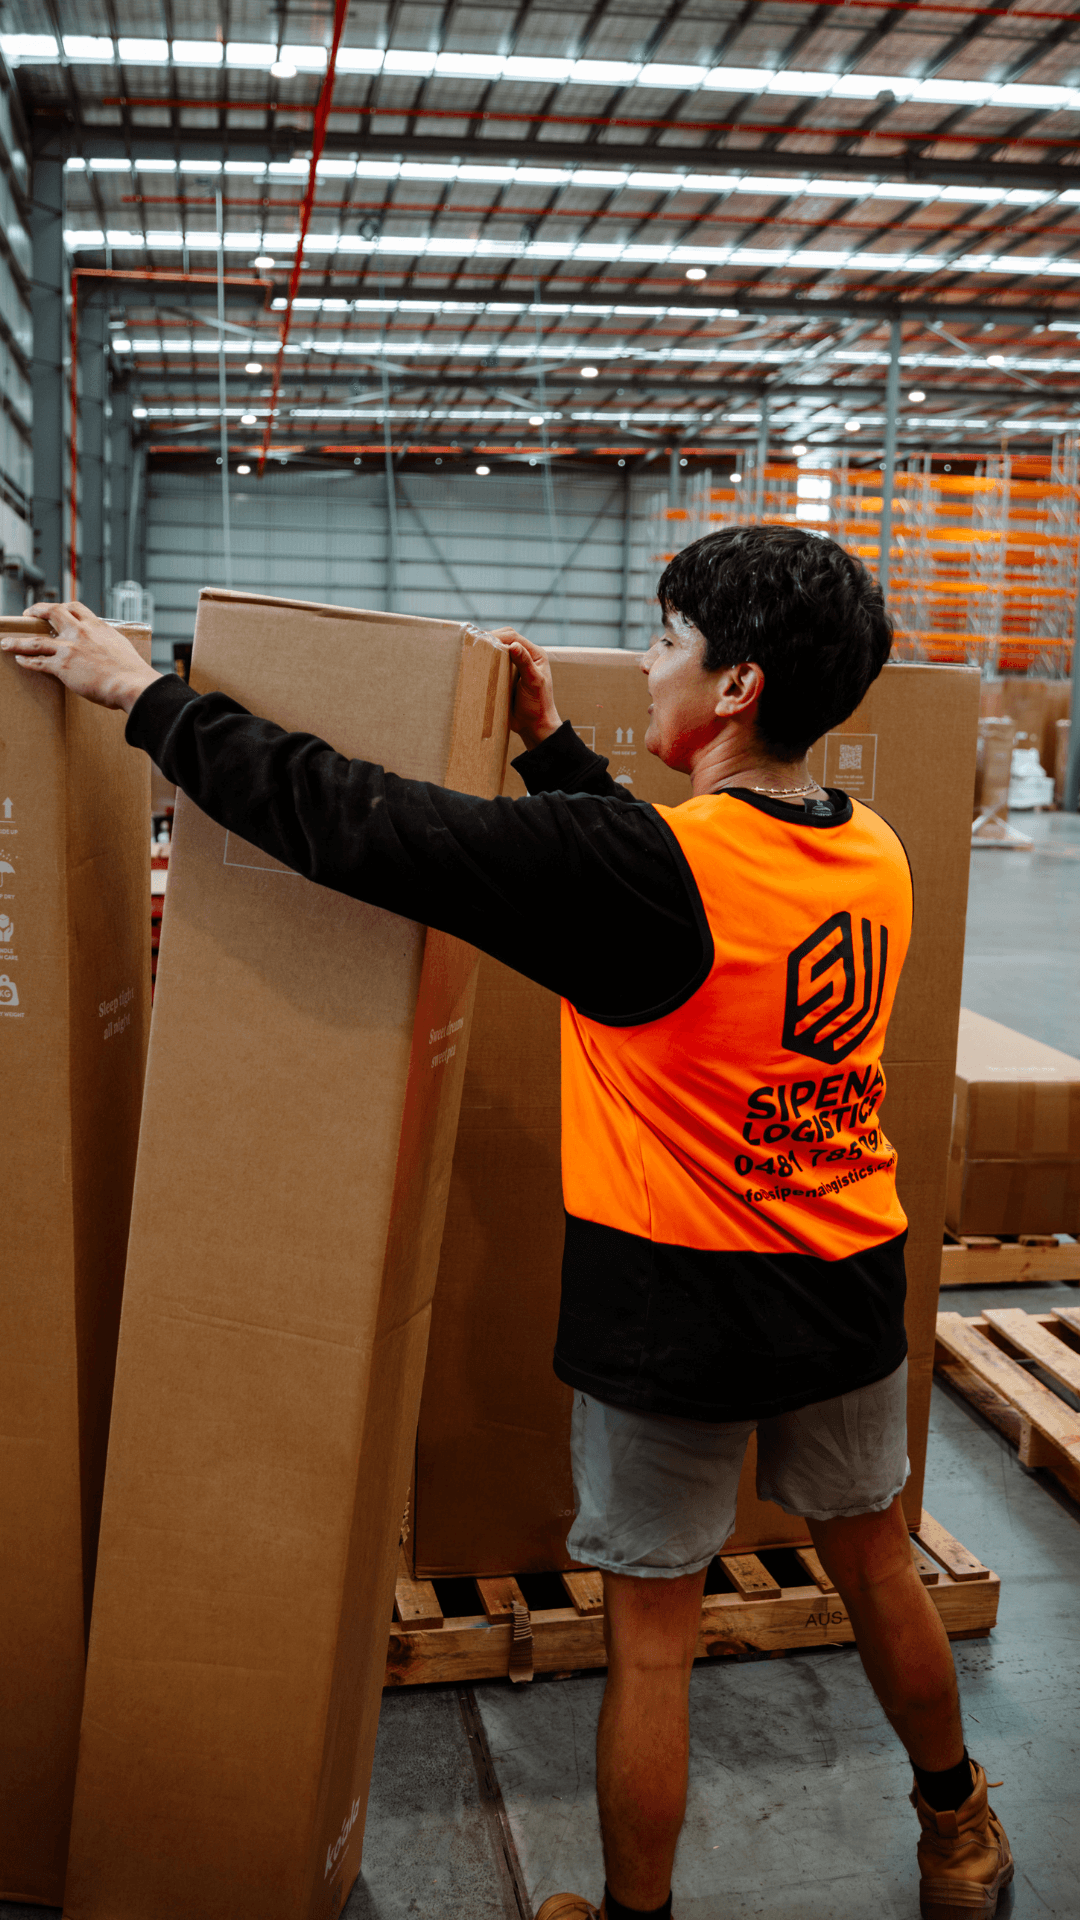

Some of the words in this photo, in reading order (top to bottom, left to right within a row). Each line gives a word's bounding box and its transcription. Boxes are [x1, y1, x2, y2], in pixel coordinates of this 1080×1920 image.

[98, 998, 119, 1018] Sleep
[119, 986, 134, 1008] tight
[103, 1021, 113, 1040] all
[113, 1013, 131, 1034] night
[428, 1025, 447, 1045] Sweet
[746, 1064, 884, 1122] SIPENA
[742, 1090, 882, 1146] LOGISTICS
[734, 1150, 803, 1178] 0481
[323, 1795, 361, 1880] koala
